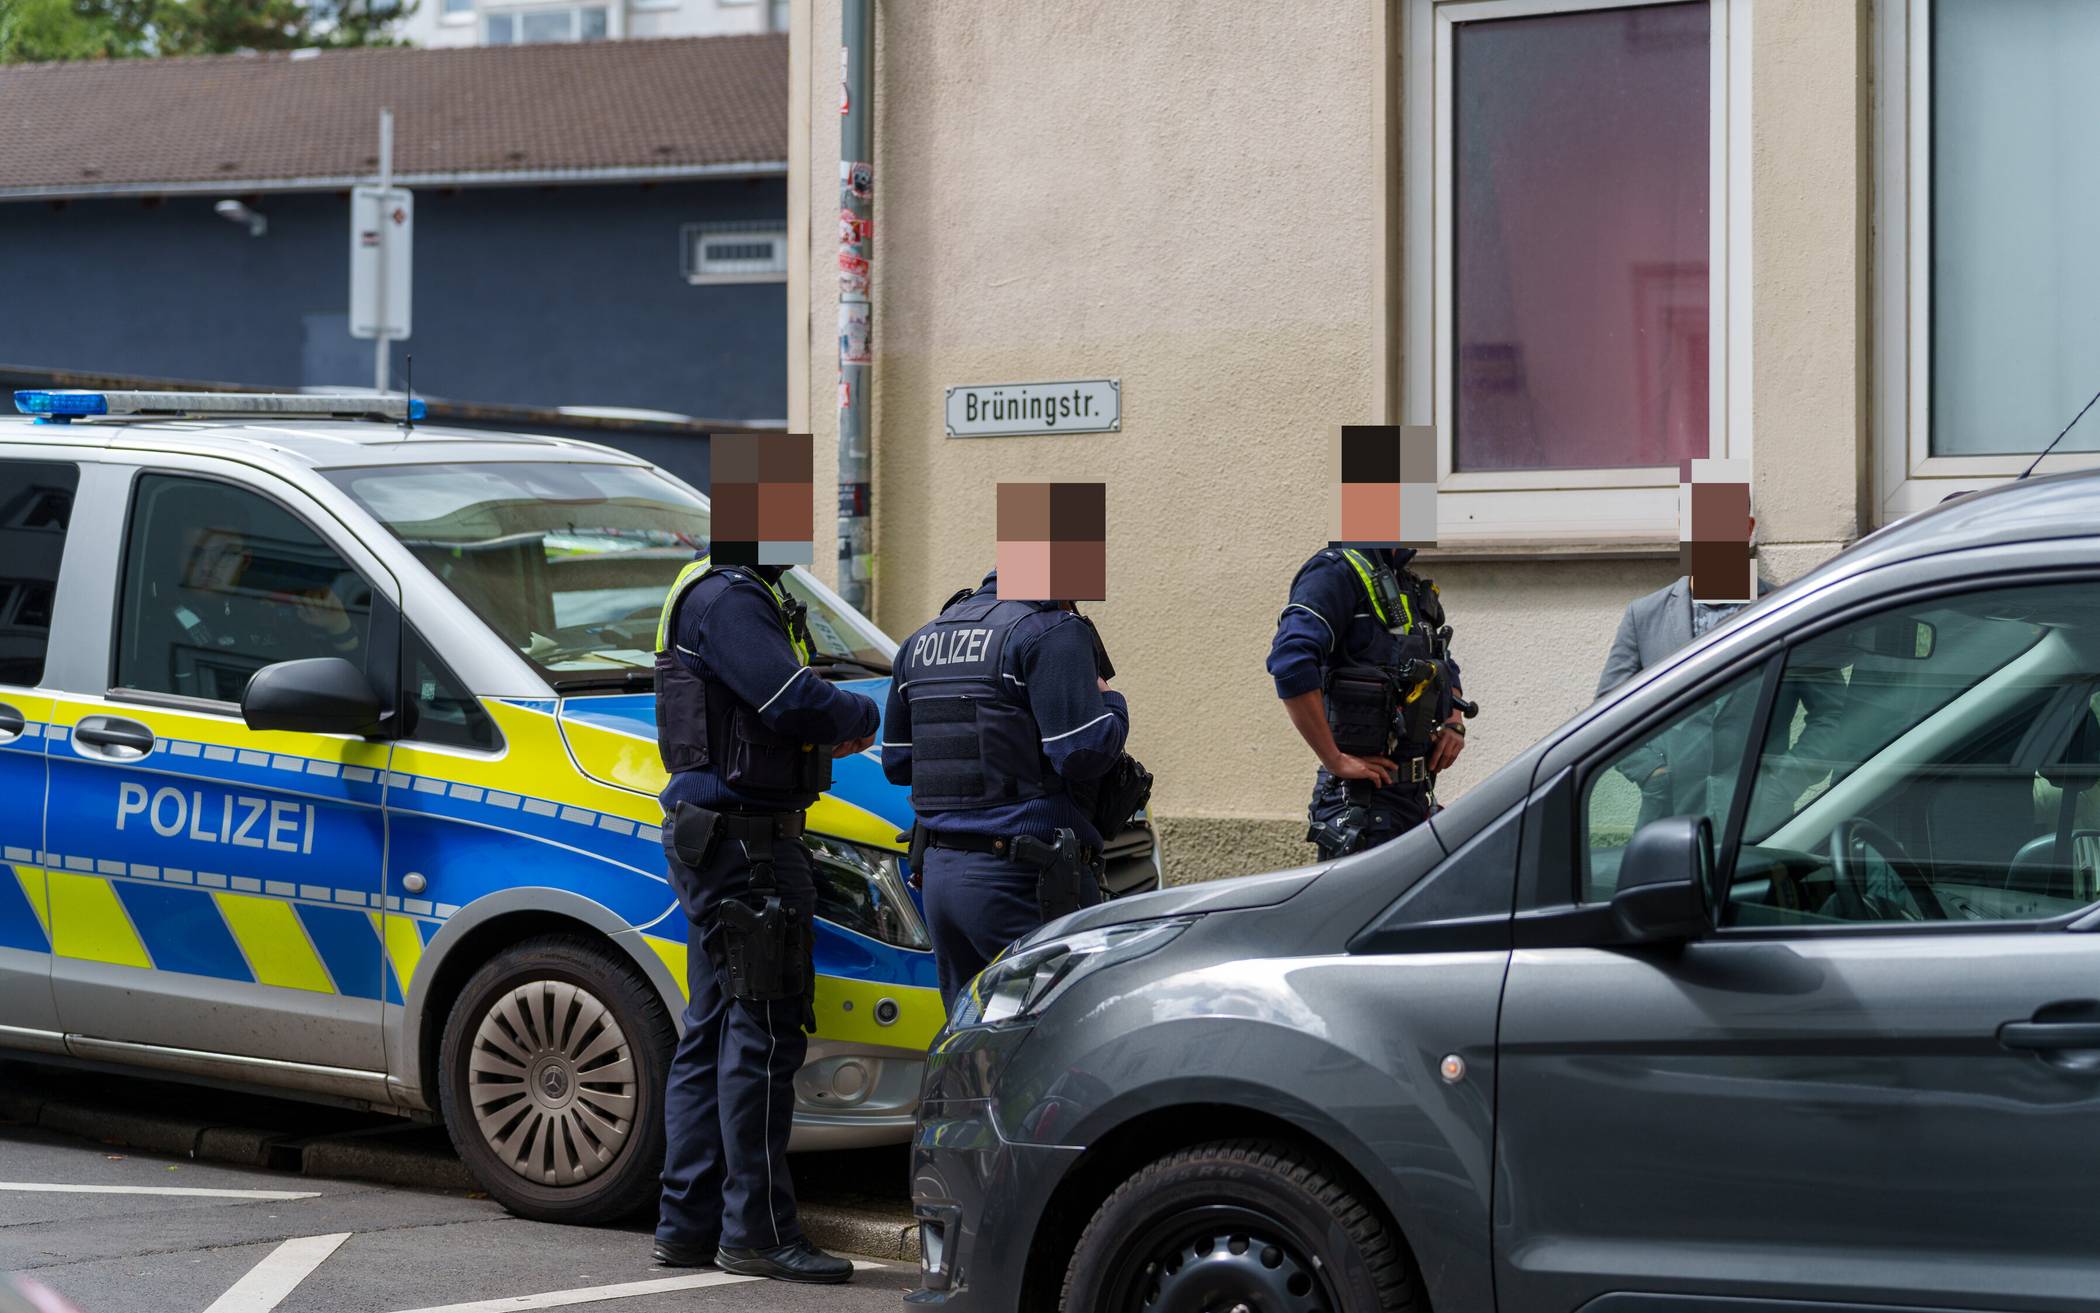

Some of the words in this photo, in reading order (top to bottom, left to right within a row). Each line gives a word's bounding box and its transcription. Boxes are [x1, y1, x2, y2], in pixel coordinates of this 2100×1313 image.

[966, 390, 1099, 426] Brüningstr.
[911, 628, 994, 668] POLIZEI
[116, 782, 315, 855] POLIZEI
